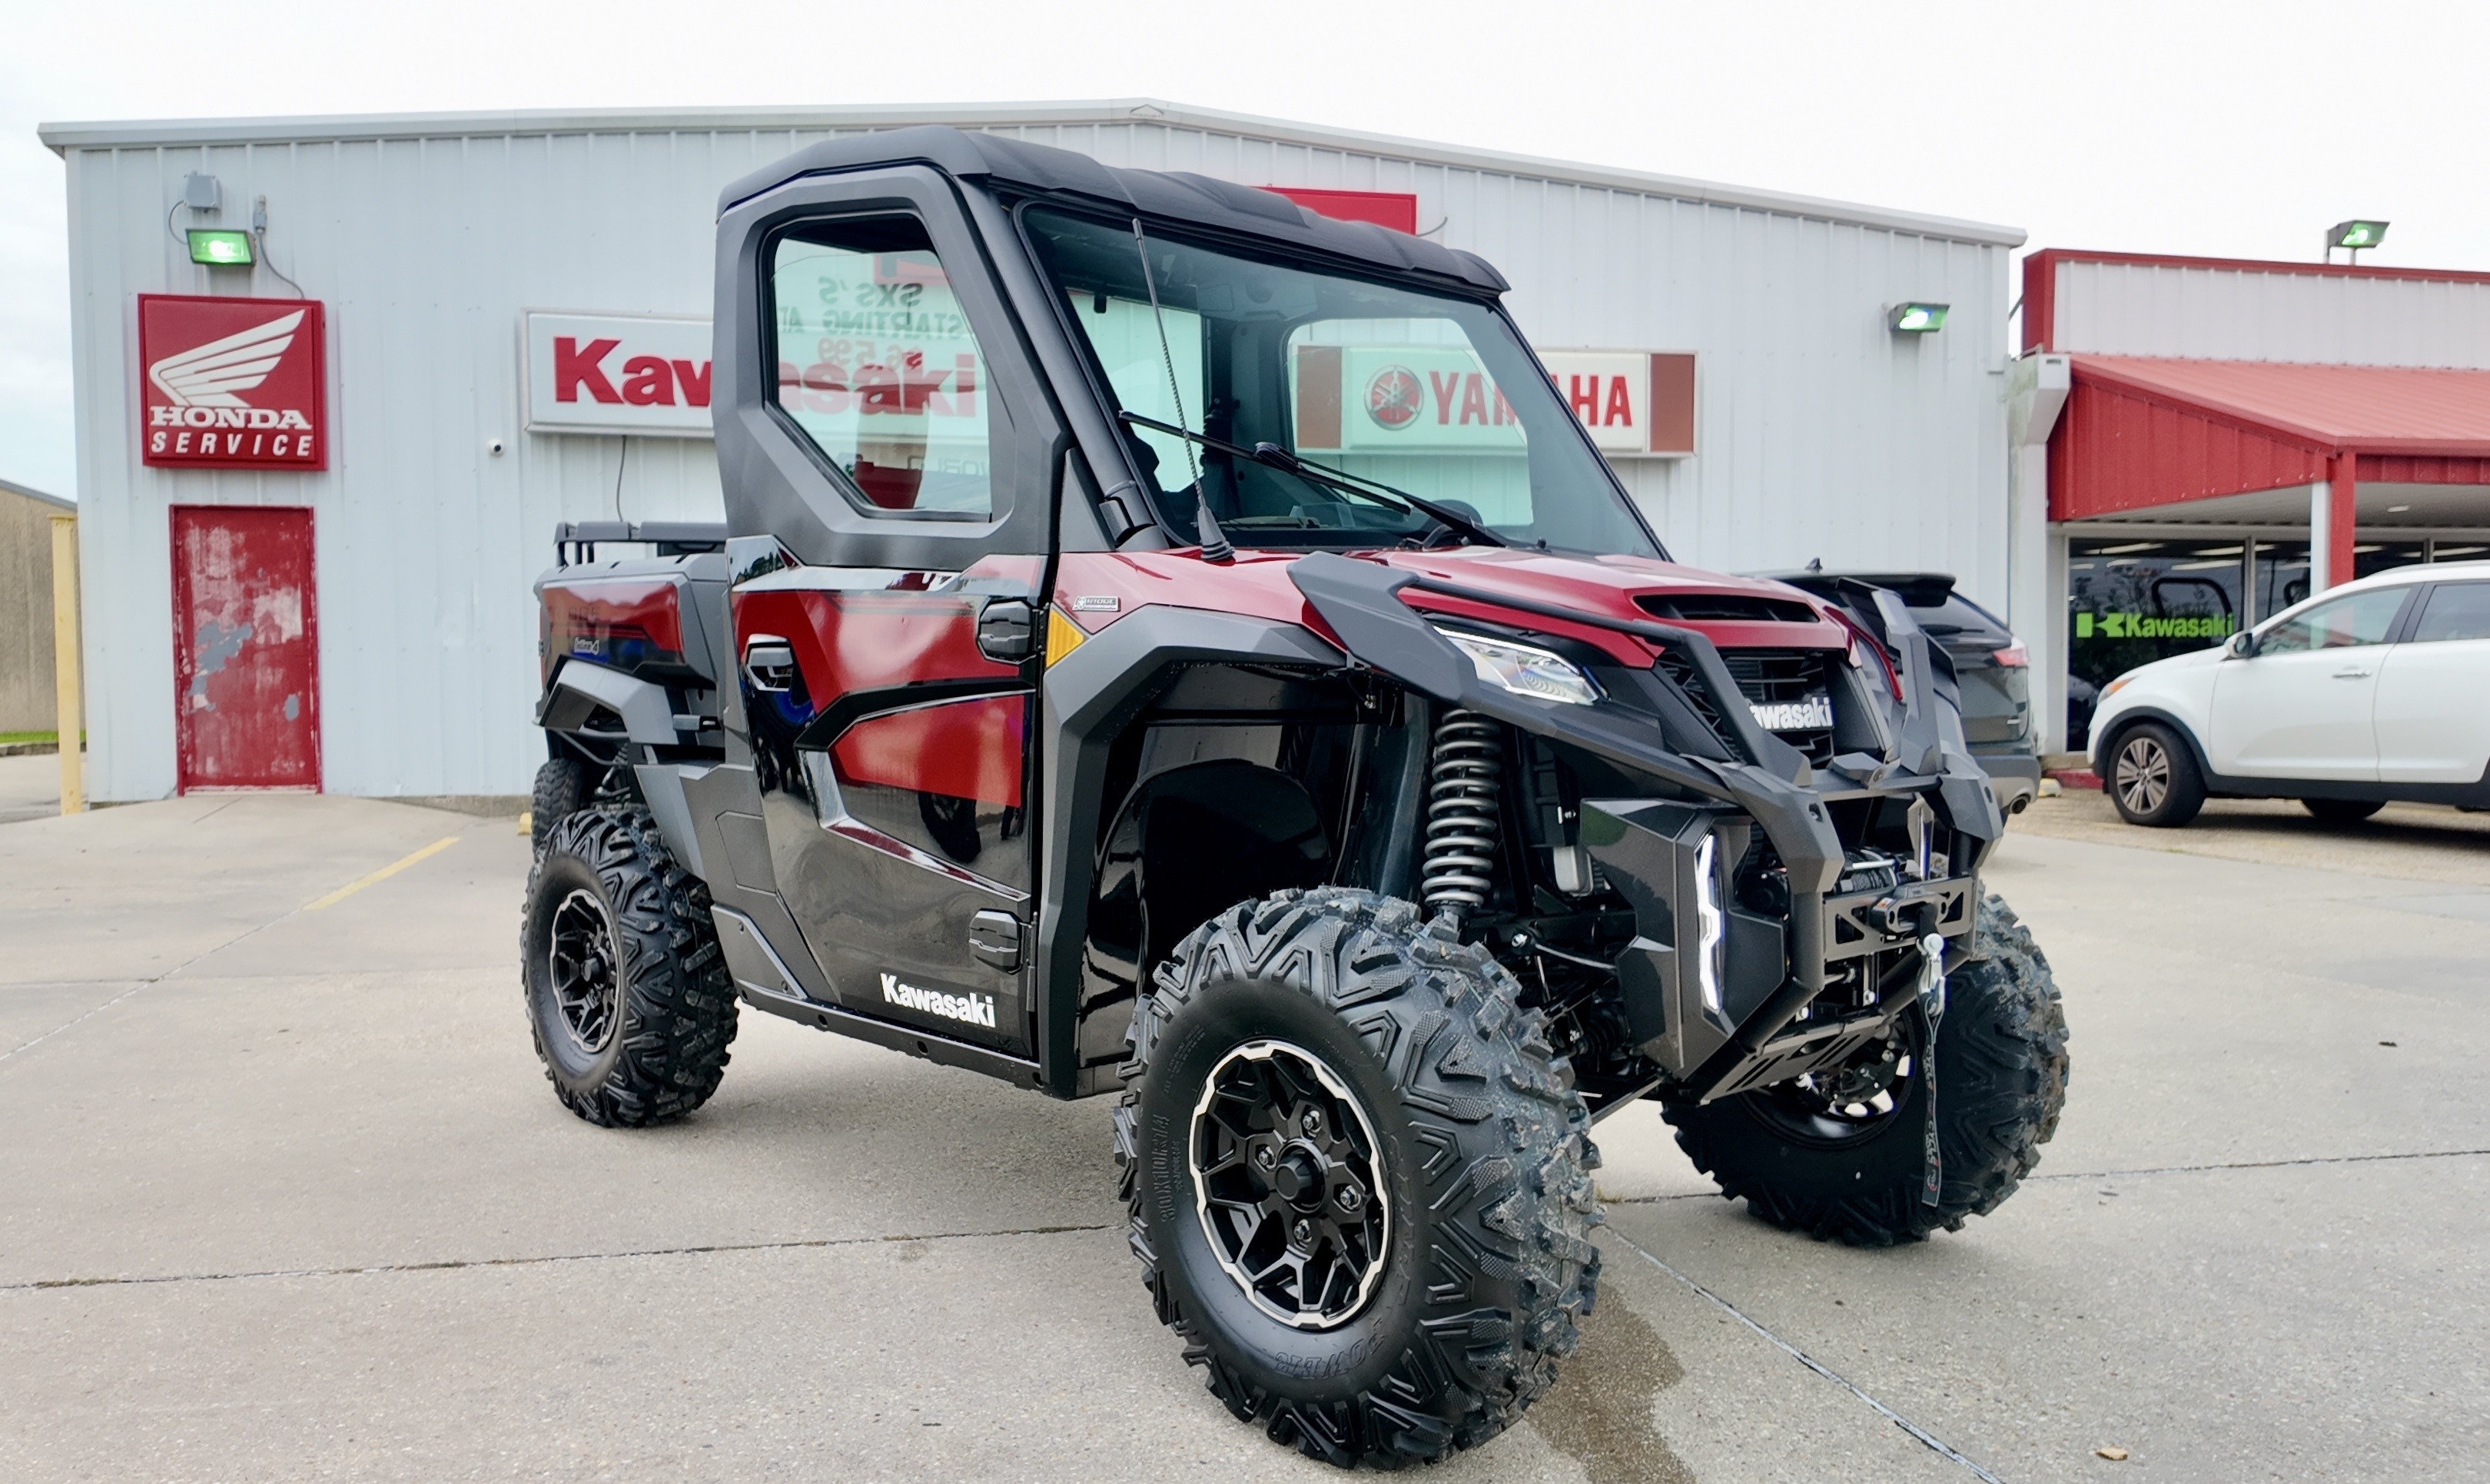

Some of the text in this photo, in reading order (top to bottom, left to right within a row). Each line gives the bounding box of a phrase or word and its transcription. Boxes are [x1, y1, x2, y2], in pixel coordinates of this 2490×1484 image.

[150, 406, 312, 430] HONDA
[151, 431, 312, 456] SERVICE
[2126, 613, 2234, 638] Kawasaki
[880, 972, 996, 1028] Kawasaki
